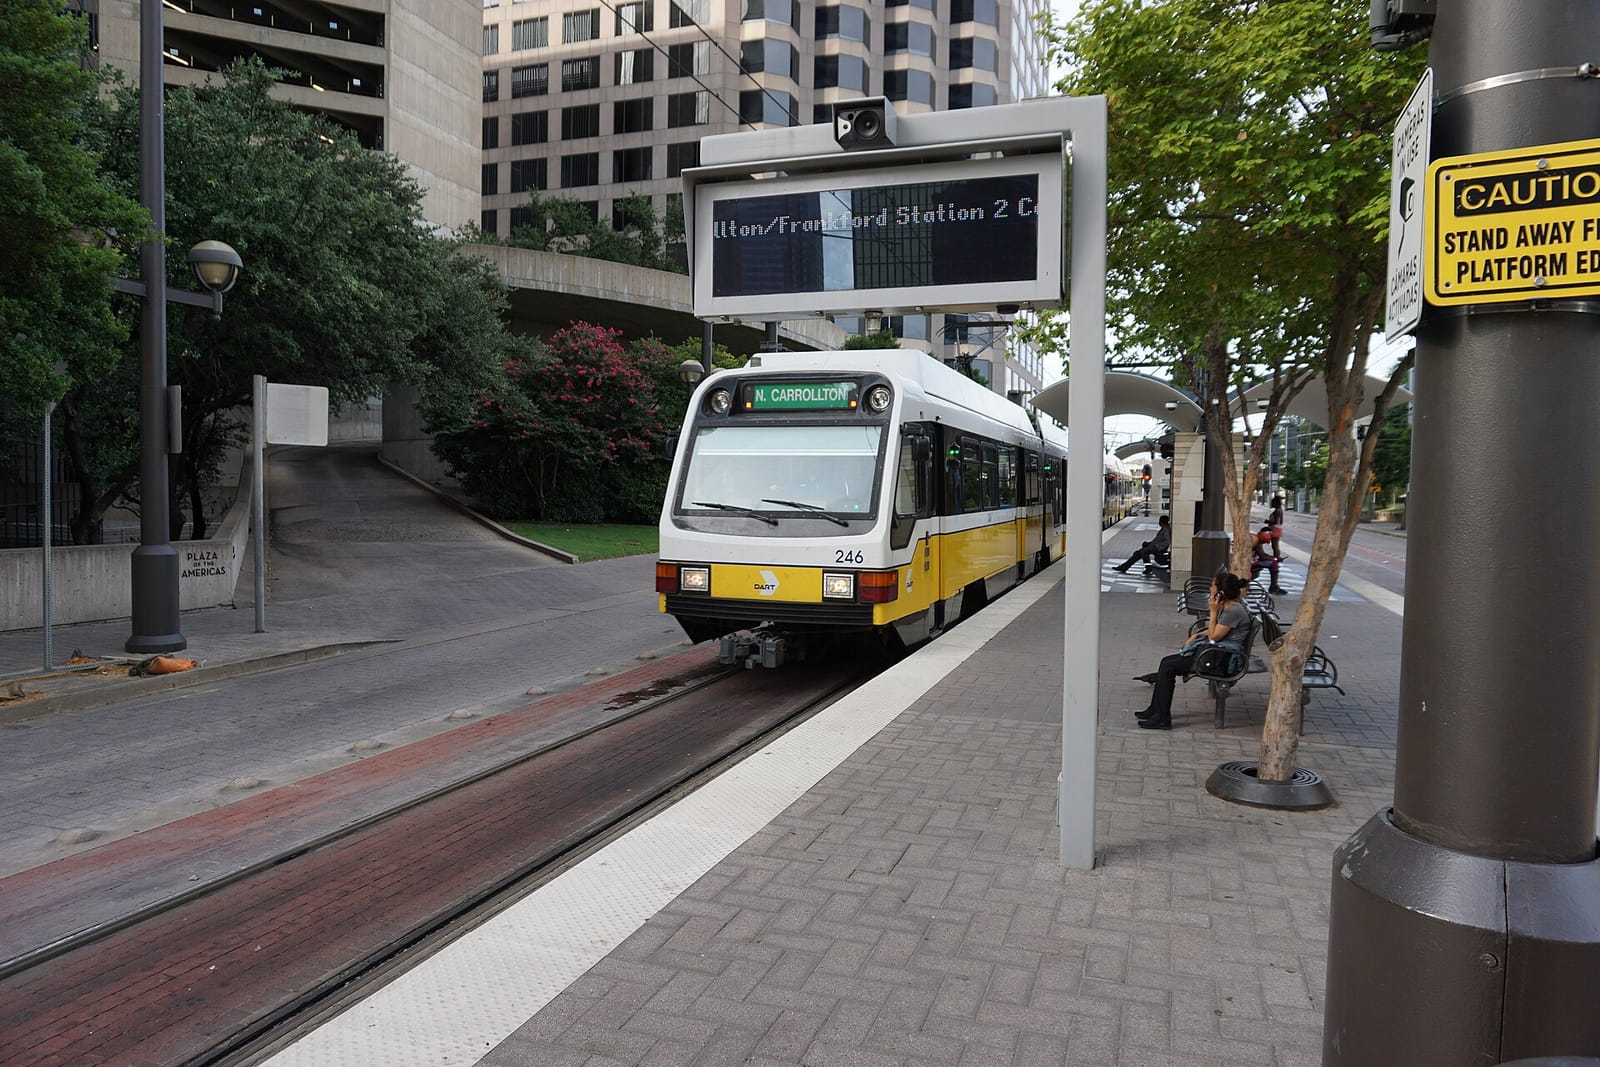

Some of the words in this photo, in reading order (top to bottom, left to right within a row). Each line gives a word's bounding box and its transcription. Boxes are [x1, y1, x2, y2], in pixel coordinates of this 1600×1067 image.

[1397, 100, 1425, 158] CAMERAS
[1407, 135, 1419, 168] USE
[1460, 171, 1600, 210] CAUTIO
[896, 203, 984, 225] Station
[994, 199, 1008, 218] 2
[1444, 227, 1508, 254] STAND
[1515, 220, 1575, 248] AWAY
[1457, 252, 1568, 284] PLATFORM
[1388, 281, 1418, 321] ACTIVADAS
[755, 389, 767, 402] N.
[770, 388, 846, 402] CARROLLTON
[187, 551, 218, 560] PLAZA
[835, 549, 864, 564] 246
[181, 566, 226, 577] AMERICAS
[754, 583, 776, 591] DART
